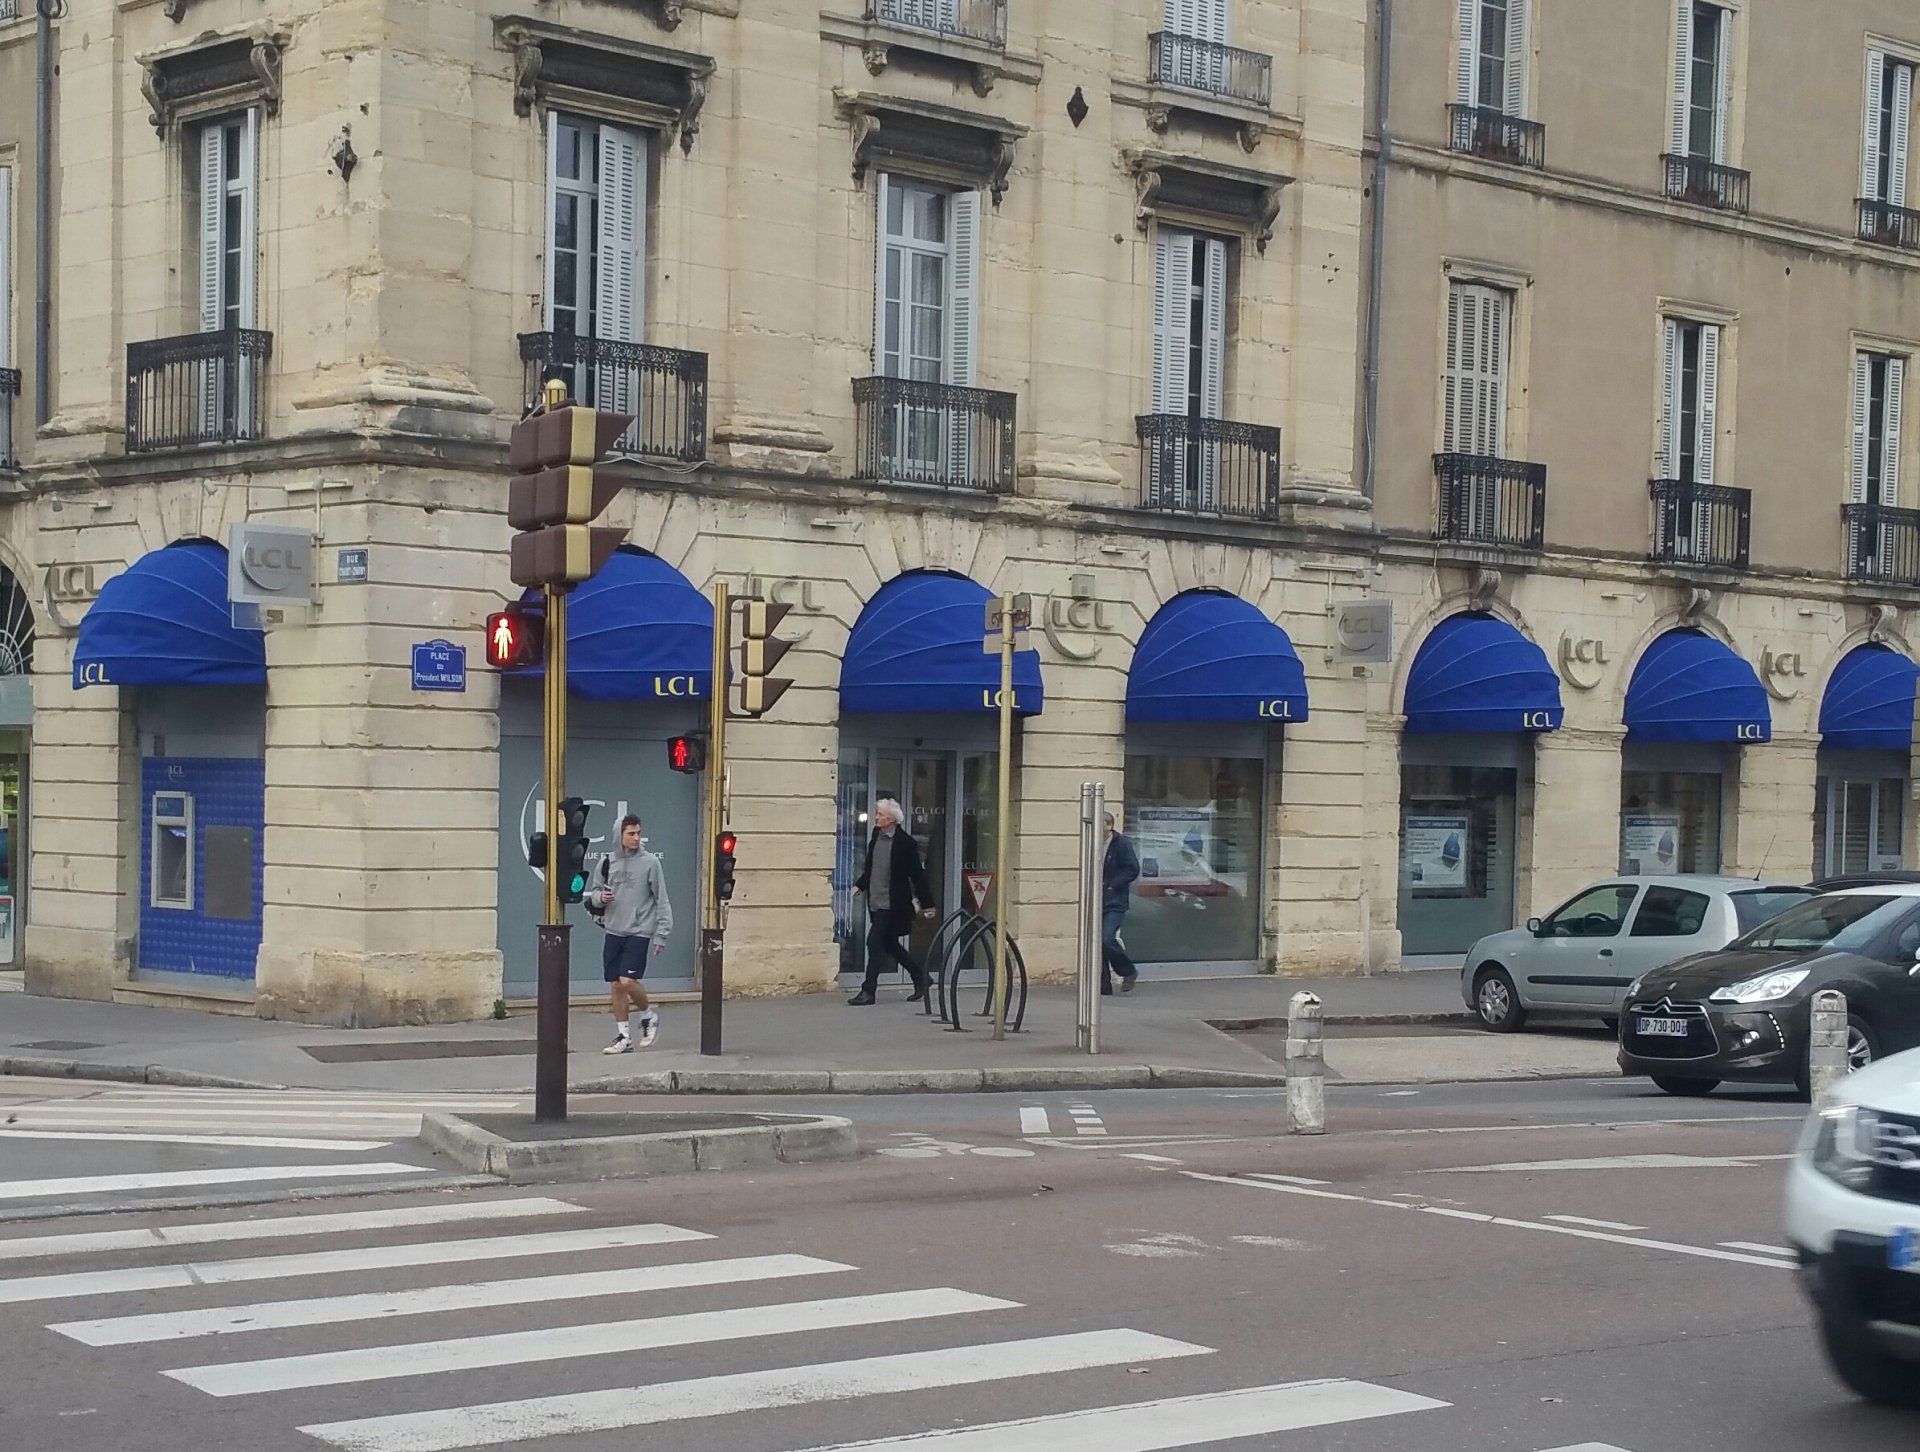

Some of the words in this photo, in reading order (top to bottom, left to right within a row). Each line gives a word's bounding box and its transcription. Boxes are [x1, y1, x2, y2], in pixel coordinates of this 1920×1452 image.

[247, 547, 302, 569] LCL
[346, 554, 359, 563] RUE
[52, 565, 102, 596] LCL
[1052, 600, 1113, 630] LCL
[1343, 618, 1383, 633] LCL
[430, 652, 450, 660] PLACE
[1564, 637, 1610, 663] LCL
[80, 663, 110, 682] LCL
[1764, 652, 1808, 676] LCL
[440, 673, 463, 682] WILSON
[655, 676, 700, 696] LCL
[983, 689, 1021, 708] LCL
[1259, 700, 1292, 717] LCL
[1523, 712, 1554, 728] LCL
[1737, 724, 1763, 739] LCL
